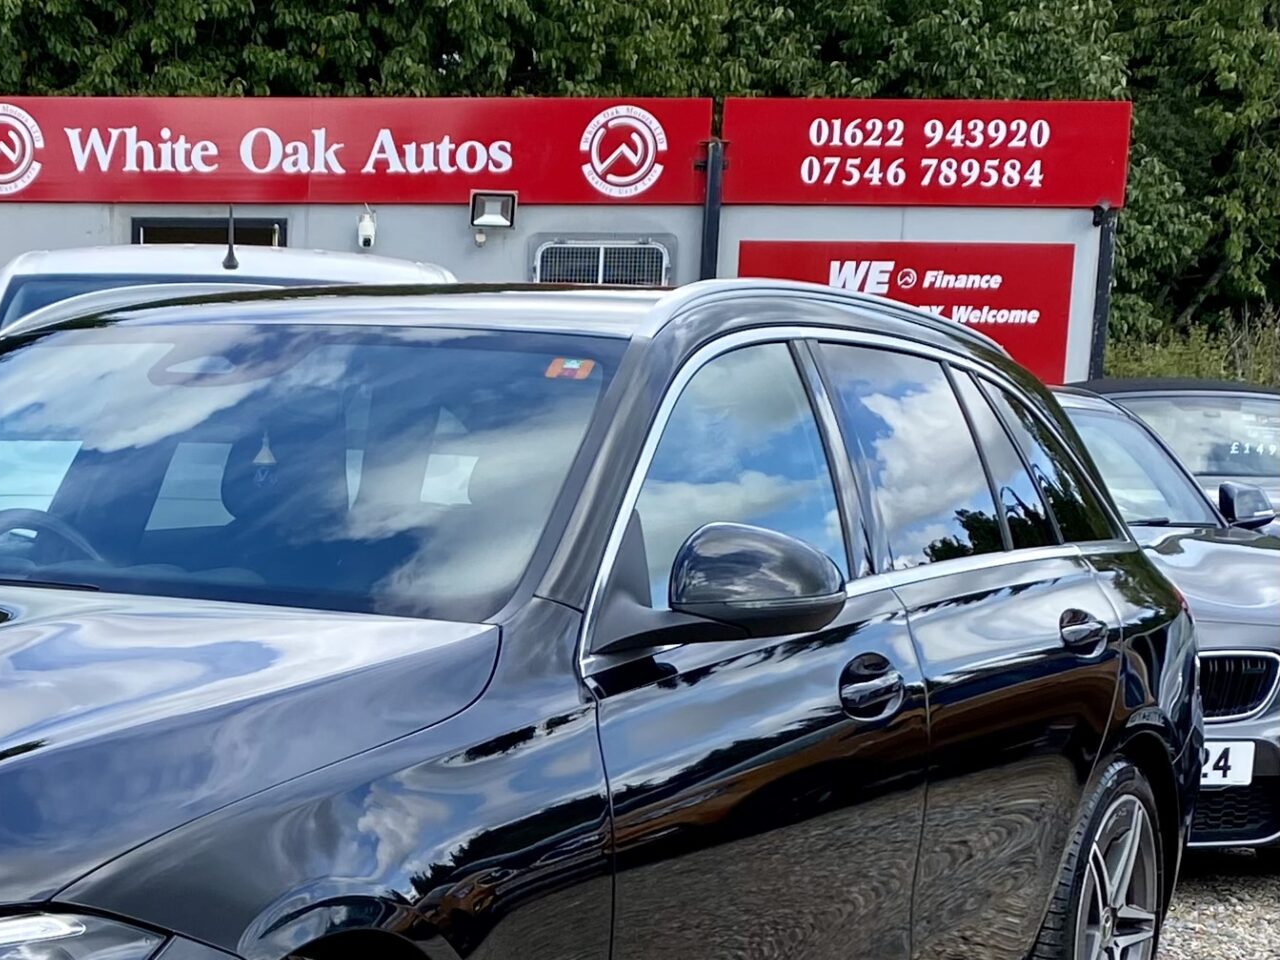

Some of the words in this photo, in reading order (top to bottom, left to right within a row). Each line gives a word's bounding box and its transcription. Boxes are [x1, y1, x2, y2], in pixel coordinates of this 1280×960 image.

[809, 118, 904, 147] 01622
[923, 119, 1050, 148] 943920
[64, 126, 218, 173] White
[239, 127, 346, 174] Oak
[362, 128, 513, 174] Autos
[800, 156, 906, 186] 07546
[920, 158, 1044, 188] 789584
[828, 260, 895, 294] WE
[922, 270, 1002, 290] Finance
[951, 305, 1040, 325] Welcome
